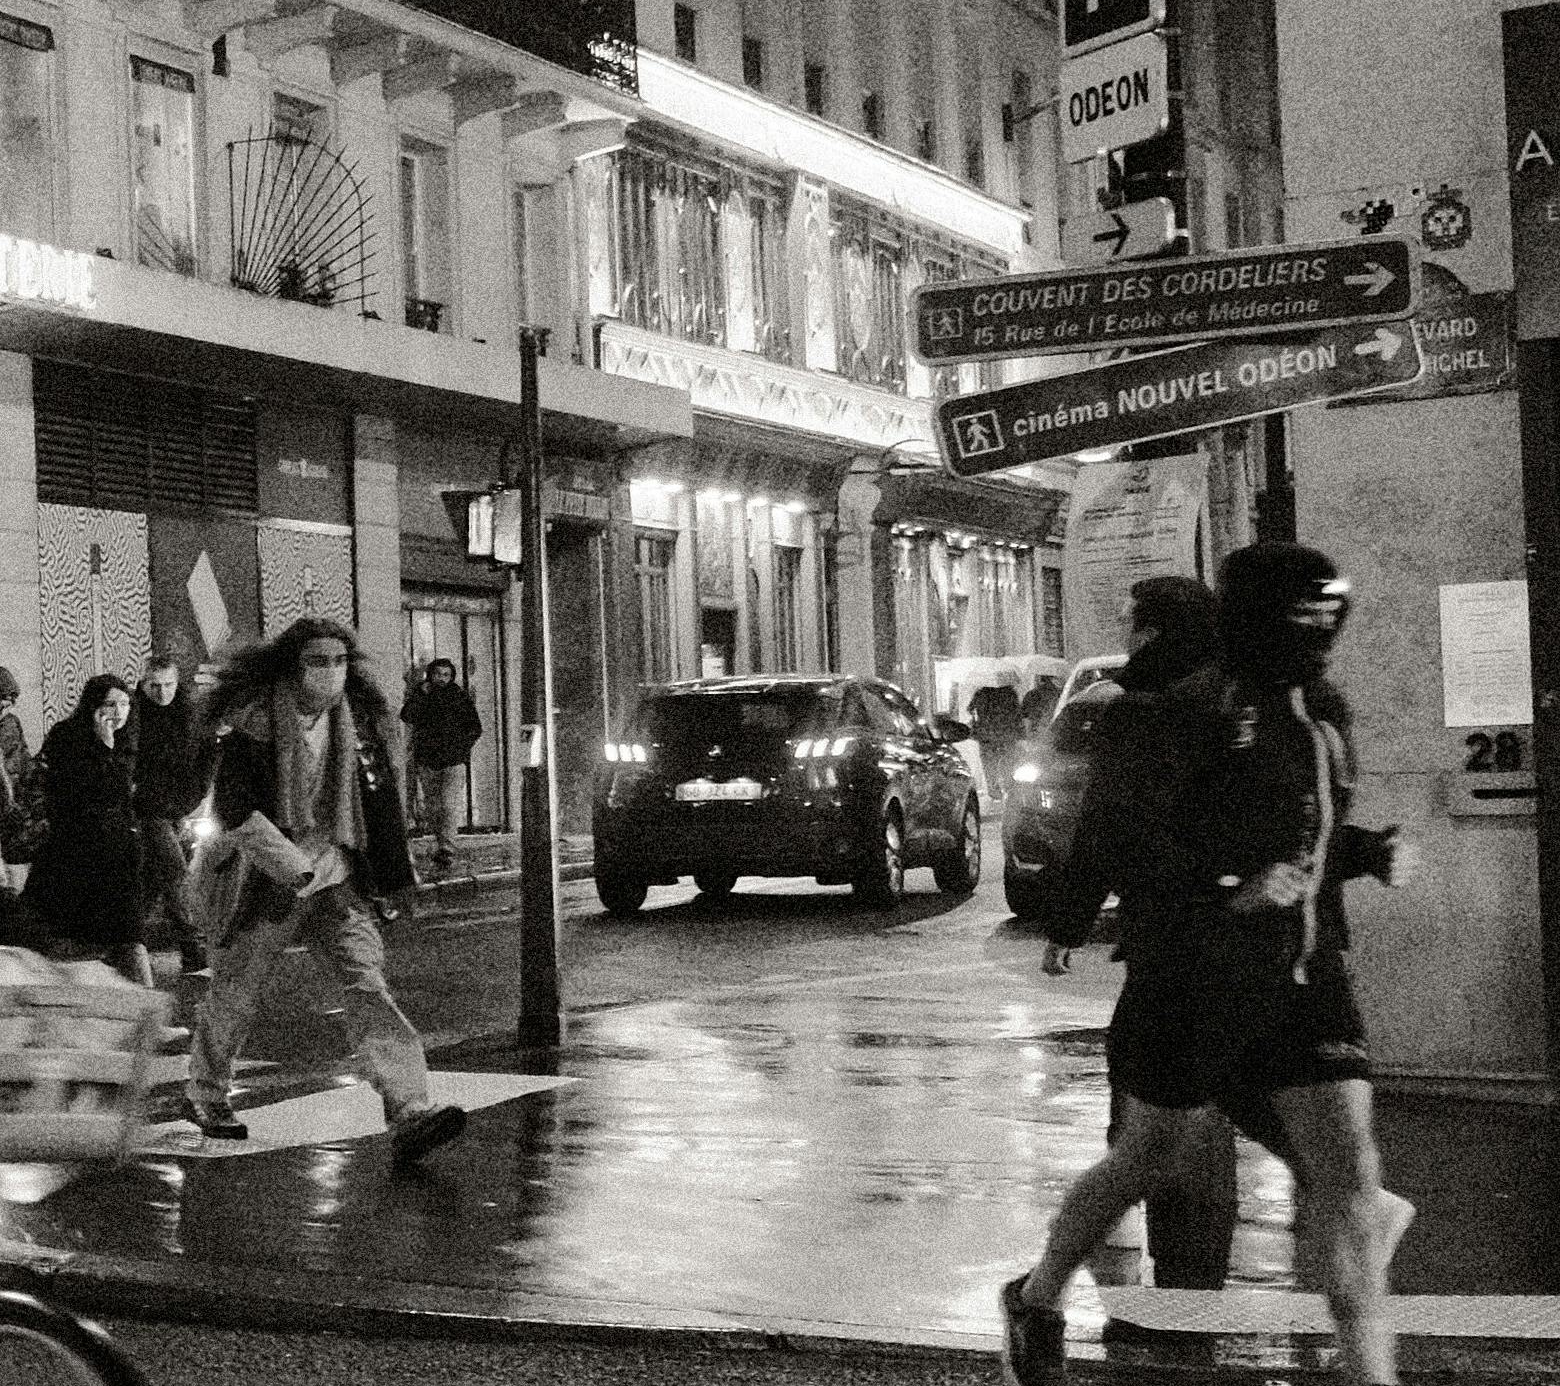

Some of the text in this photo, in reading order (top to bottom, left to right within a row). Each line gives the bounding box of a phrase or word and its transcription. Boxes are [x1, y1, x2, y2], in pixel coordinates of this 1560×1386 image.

[1068, 67, 1150, 128] ODEON
[973, 257, 1328, 319] COUVENT DES CORDELIERS
[973, 325, 998, 347] 15
[1003, 322, 1045, 342] Rue
[1052, 318, 1080, 339] de
[1171, 305, 1199, 327] de
[1207, 297, 1320, 323] Médecine
[1012, 340, 1338, 439] cinéma NOUVEL ODÉON
